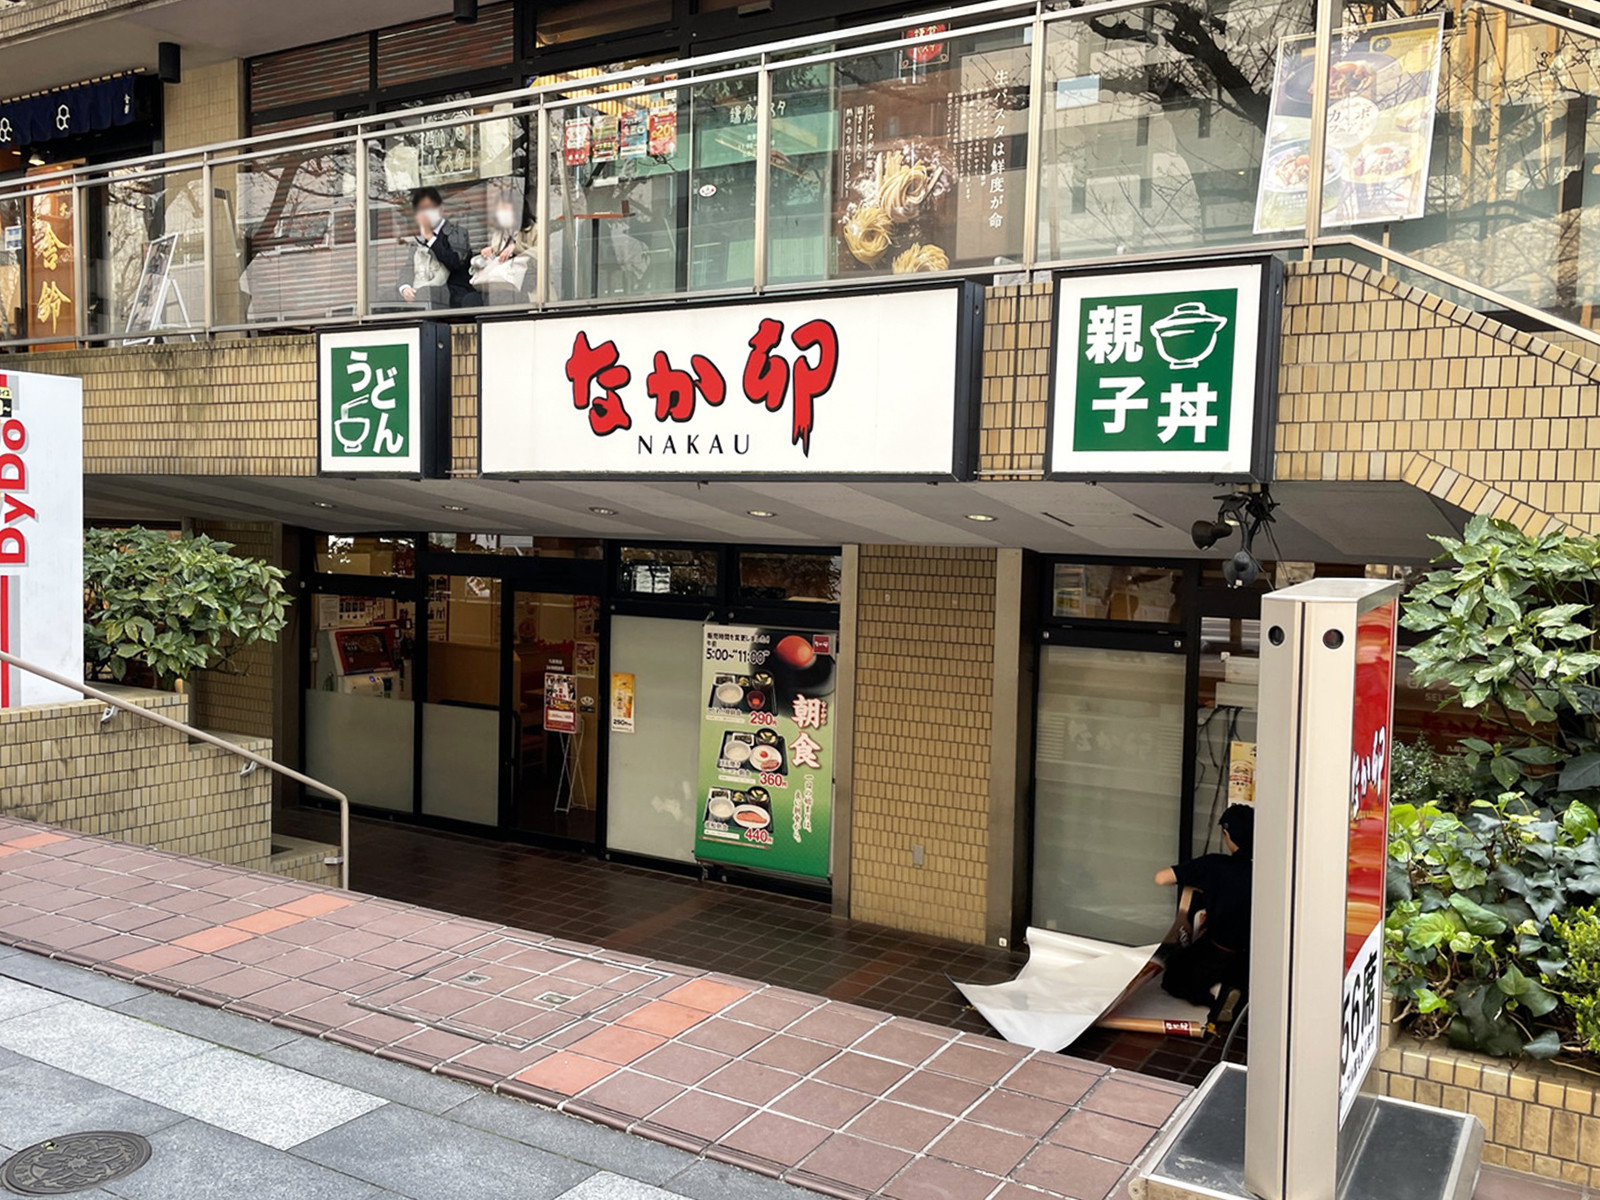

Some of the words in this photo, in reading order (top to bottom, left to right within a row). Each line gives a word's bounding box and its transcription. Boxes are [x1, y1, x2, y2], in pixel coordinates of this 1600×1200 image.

[988, 69, 1009, 229] 生パスタは鮮度が命
[347, 350, 404, 454] うどん
[566, 318, 839, 458] なか卯
[638, 434, 749, 454] NAKAU
[0, 419, 35, 563] DyDo
[790, 694, 822, 768] 朝食
